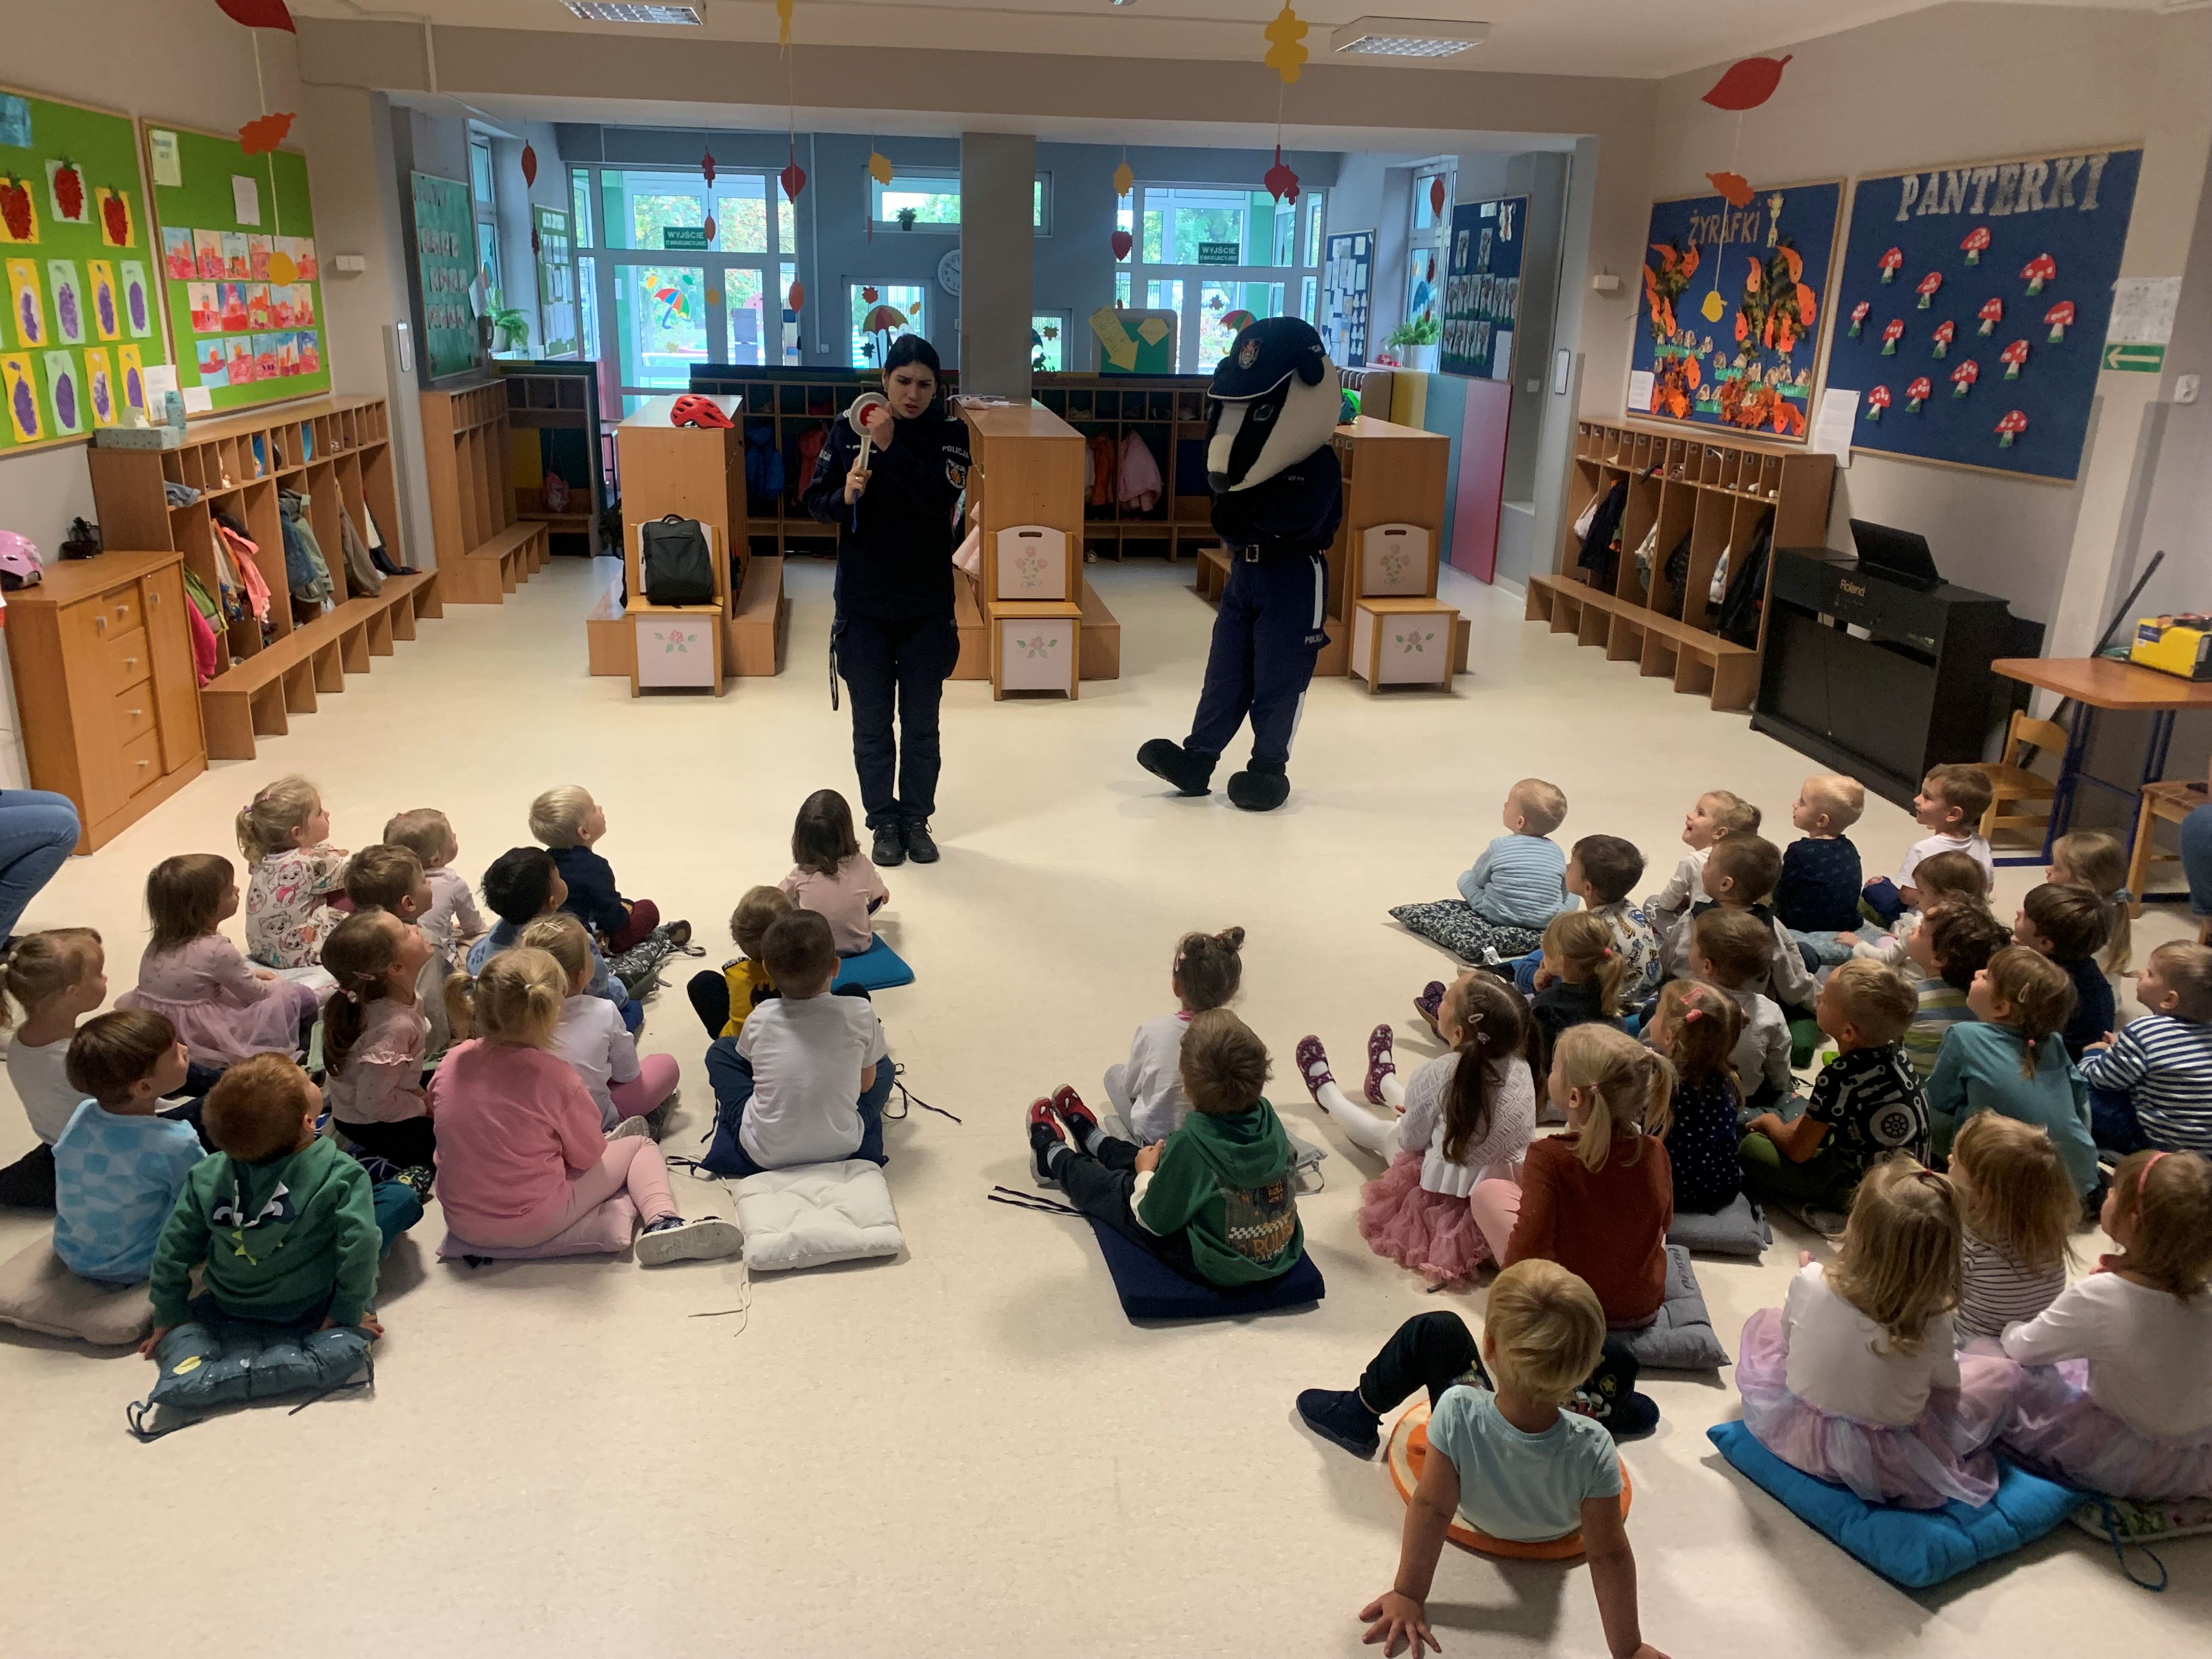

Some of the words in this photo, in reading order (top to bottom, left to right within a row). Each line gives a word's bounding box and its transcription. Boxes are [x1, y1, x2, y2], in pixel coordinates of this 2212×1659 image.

[1896, 153, 2109, 221] PANTERKI
[667, 230, 704, 239] WYJŚCIE
[1201, 246, 1236, 254] WYJŚCIE
[942, 445, 969, 459] POLICJA
[1840, 579, 1865, 597] Roland
[1250, 1252, 1272, 1263] REAK
